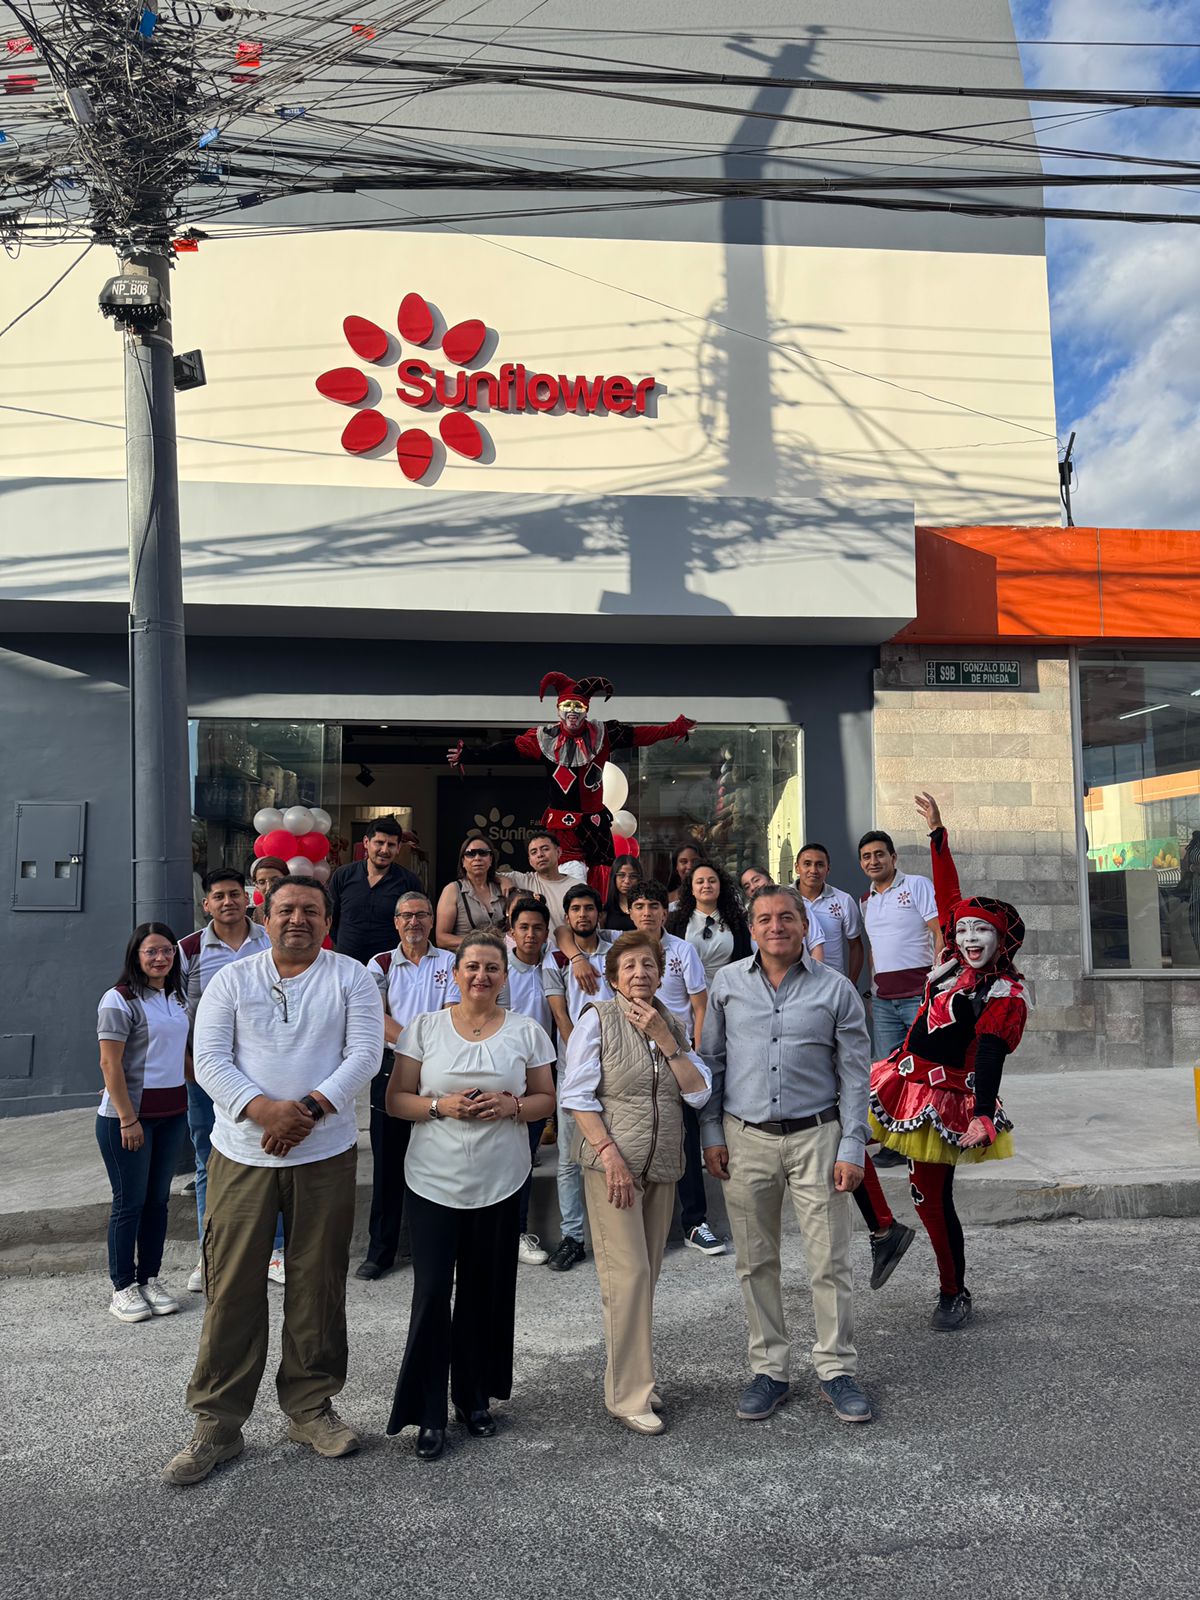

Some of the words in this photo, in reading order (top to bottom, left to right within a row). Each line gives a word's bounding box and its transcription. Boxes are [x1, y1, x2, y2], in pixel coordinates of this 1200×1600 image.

[112, 283, 148, 296] NP_B08
[396, 358, 656, 414] Sunflower
[940, 665, 956, 680] S9B
[963, 663, 998, 672] GONZALO
[1000, 663, 1016, 672] DIAZ
[971, 674, 981, 683] DE
[983, 674, 1010, 683] PINEDA
